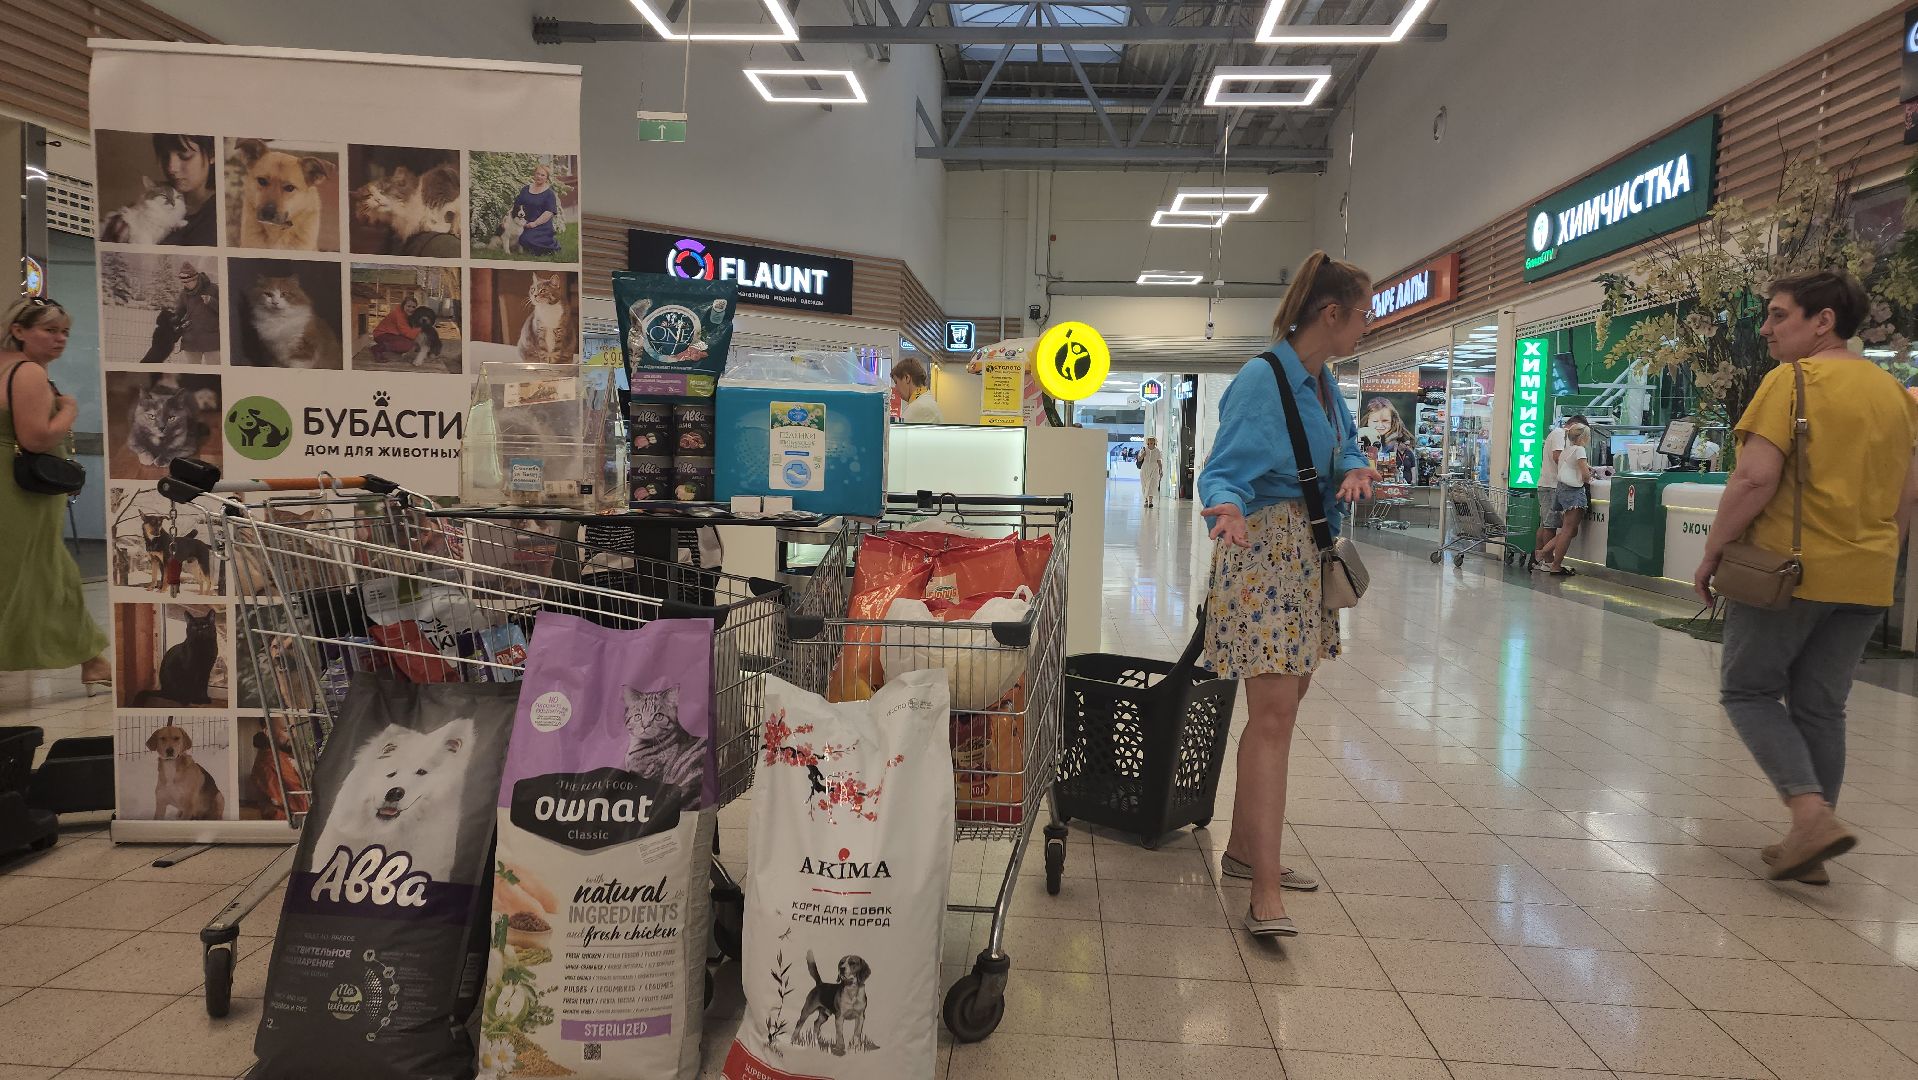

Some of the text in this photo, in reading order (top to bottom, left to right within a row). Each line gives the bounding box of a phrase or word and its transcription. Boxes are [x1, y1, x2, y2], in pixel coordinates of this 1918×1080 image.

[1556, 152, 1691, 247] ХИМЧИСТКА
[719, 256, 829, 296] FLAUNT
[1395, 269, 1429, 310] ЛАПЫ
[303, 406, 464, 440] БУБАСТИ
[1515, 341, 1541, 485] ХИМЧИСТКА
[304, 444, 461, 459] ДОМ ДЛЯ ЖИВОТНЫХ
[534, 794, 653, 823] ownat
[567, 829, 609, 841] Classic
[799, 855, 893, 880] AKIMA
[572, 875, 668, 905] natural
[568, 902, 679, 925] INGREDIENTS
[791, 901, 893, 916] КОРМ ДЛЯ СОБАК
[791, 913, 891, 928] СРЕДНИХ ПОРОД
[566, 923, 679, 948] and fresh chicken
[338, 983, 355, 996] No
[327, 997, 361, 1012] wheat
[584, 1021, 648, 1037] STERILIZED
